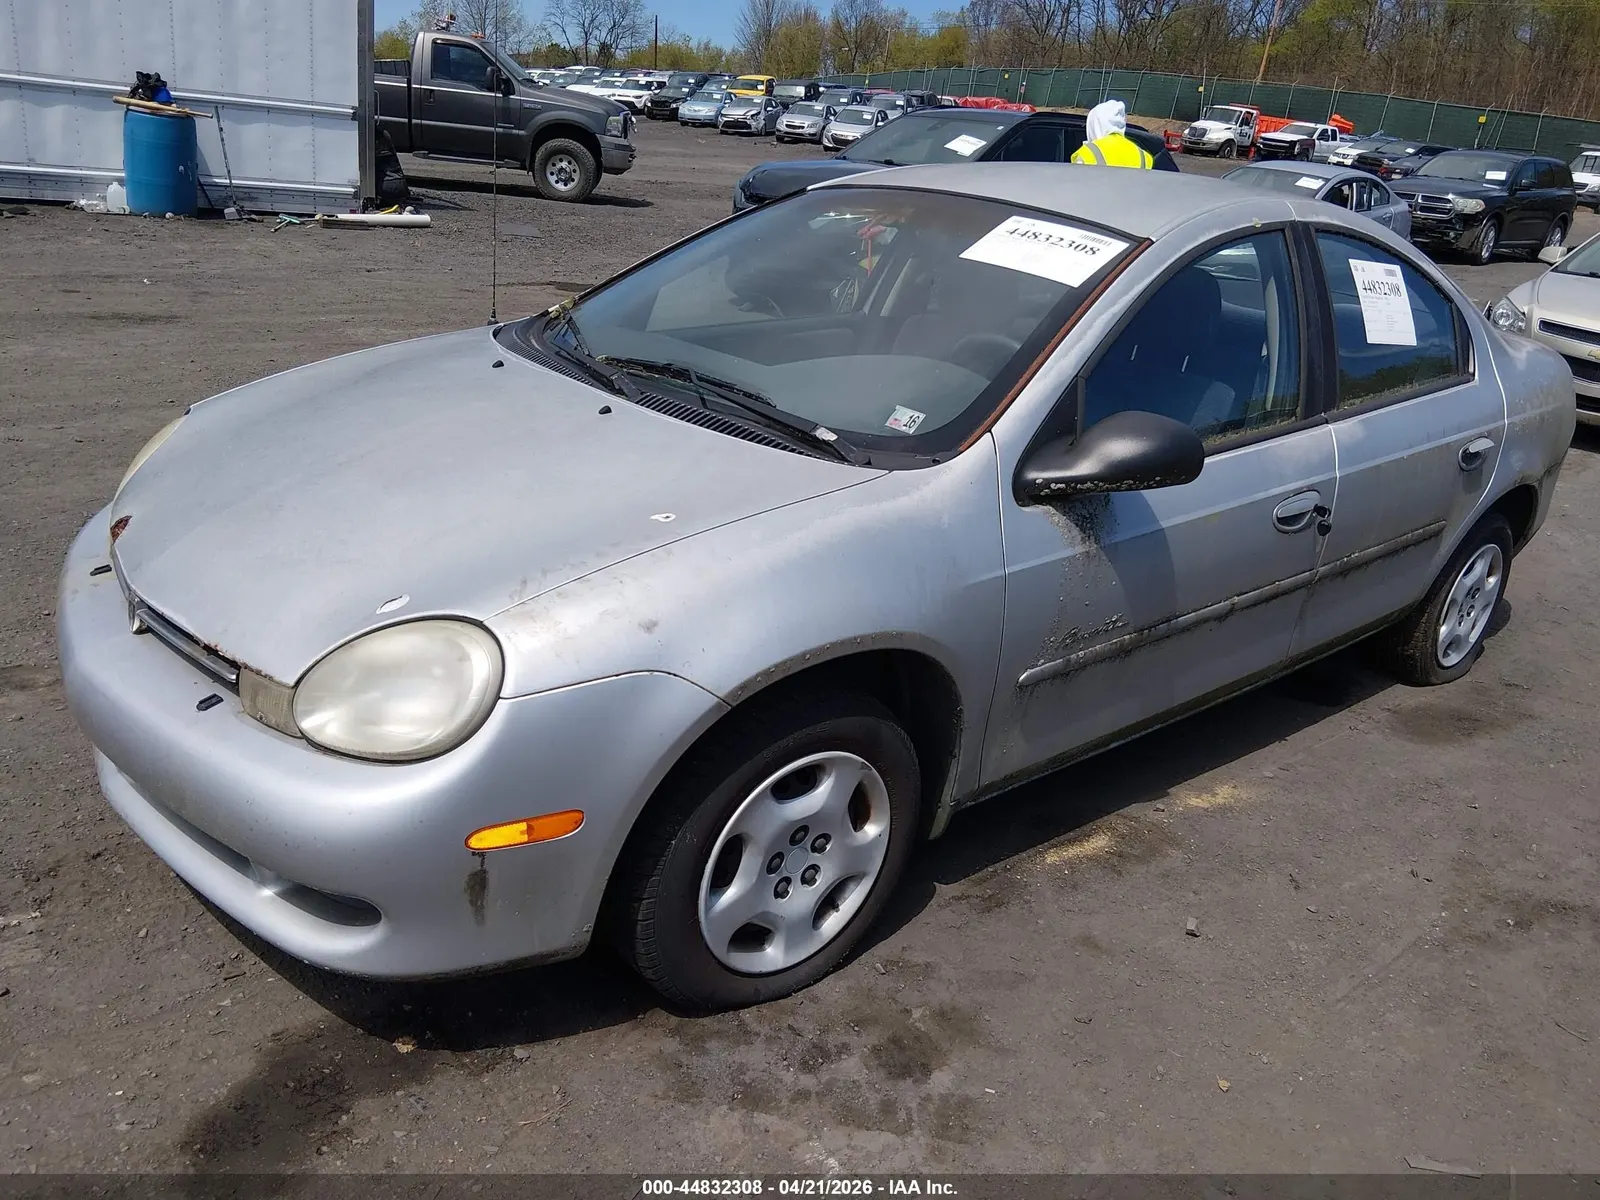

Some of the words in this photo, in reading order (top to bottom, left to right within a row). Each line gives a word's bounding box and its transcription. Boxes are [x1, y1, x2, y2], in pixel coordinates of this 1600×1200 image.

[1005, 227, 1100, 256] 44832308
[1361, 279, 1402, 297] 44832308
[903, 414, 920, 429] 16
